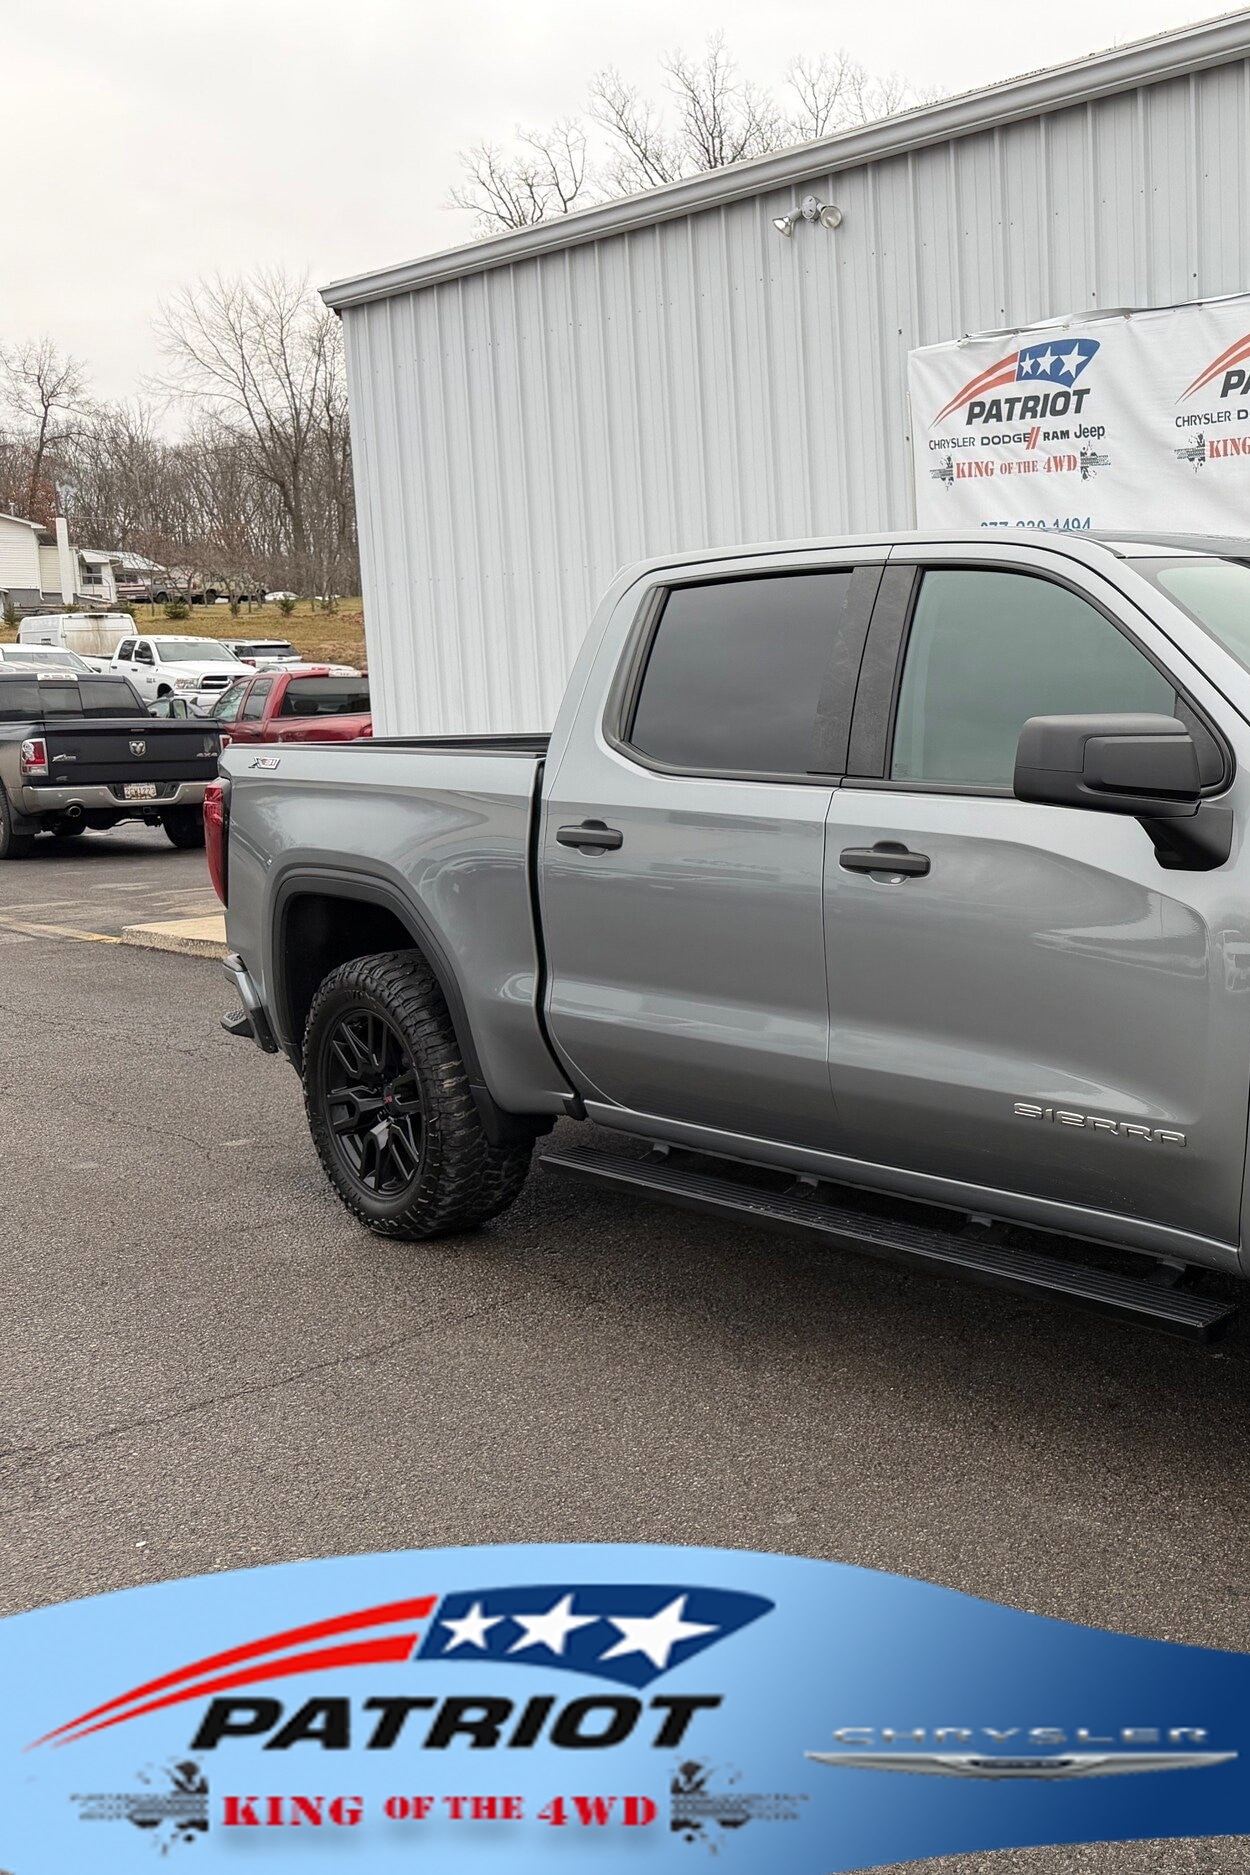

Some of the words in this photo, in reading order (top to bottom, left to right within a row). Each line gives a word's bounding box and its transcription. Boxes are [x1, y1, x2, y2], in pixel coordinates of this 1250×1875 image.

[965, 388, 1091, 426] PATRIOT
[1174, 410, 1232, 428] CHRYSLER
[928, 435, 976, 451] CHRYSLER
[980, 432, 1030, 447] DODGE
[1043, 427, 1070, 441] RAM
[1073, 423, 1106, 441] Jeep
[955, 460, 995, 480] KING
[1000, 461, 1013, 474] OF
[1016, 458, 1039, 473] THE
[1042, 454, 1078, 473] 4WD
[1014, 1102, 1187, 1147] SIERRA
